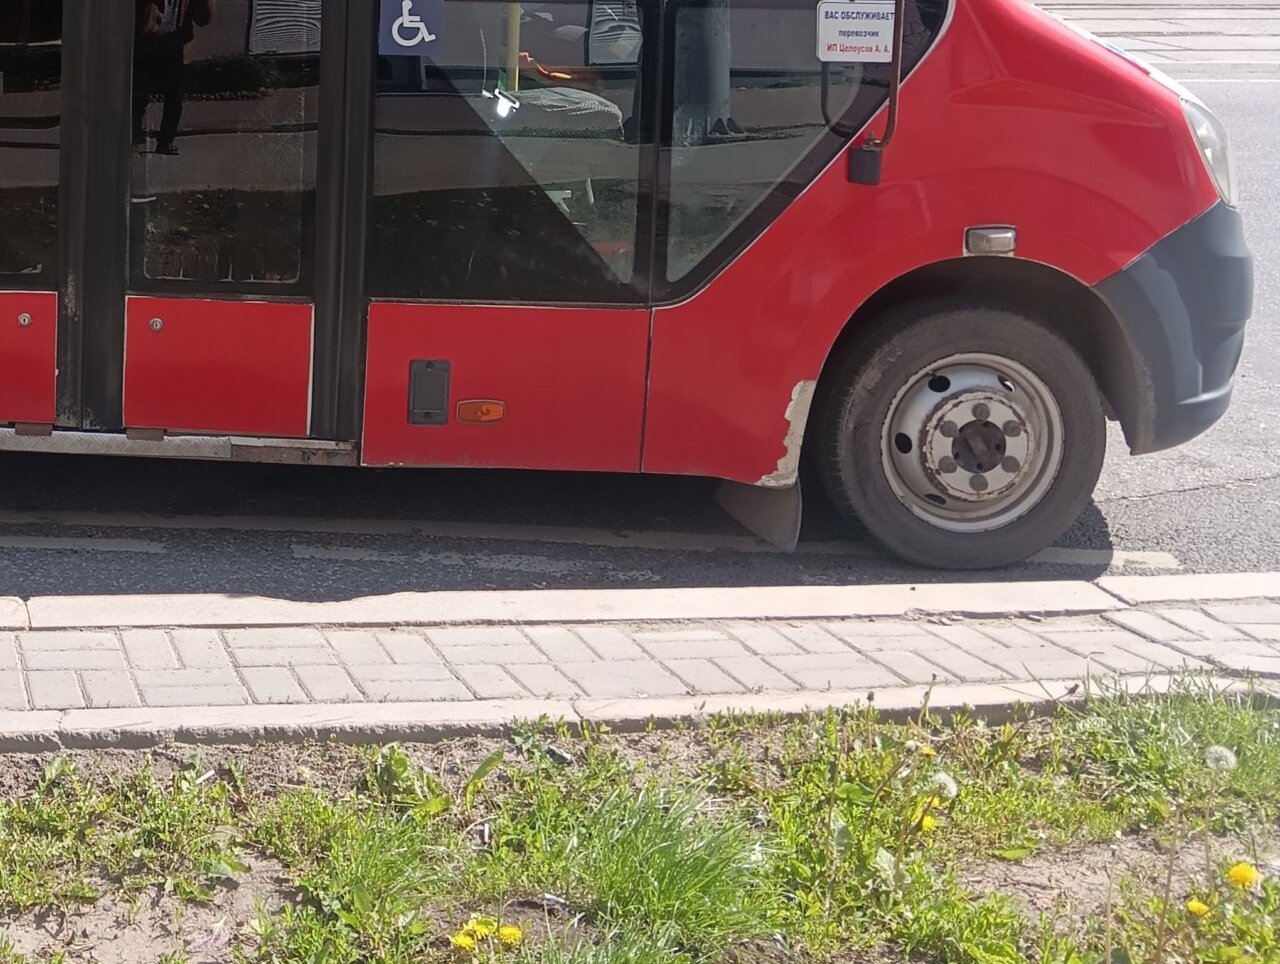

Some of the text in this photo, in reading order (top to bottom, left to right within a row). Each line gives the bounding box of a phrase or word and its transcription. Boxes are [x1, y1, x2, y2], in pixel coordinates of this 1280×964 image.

[824, 11, 895, 21] ВАС ОБСЛУЖИВАЕТ
[838, 30, 880, 38] перевозчик
[827, 43, 837, 52] ИП
